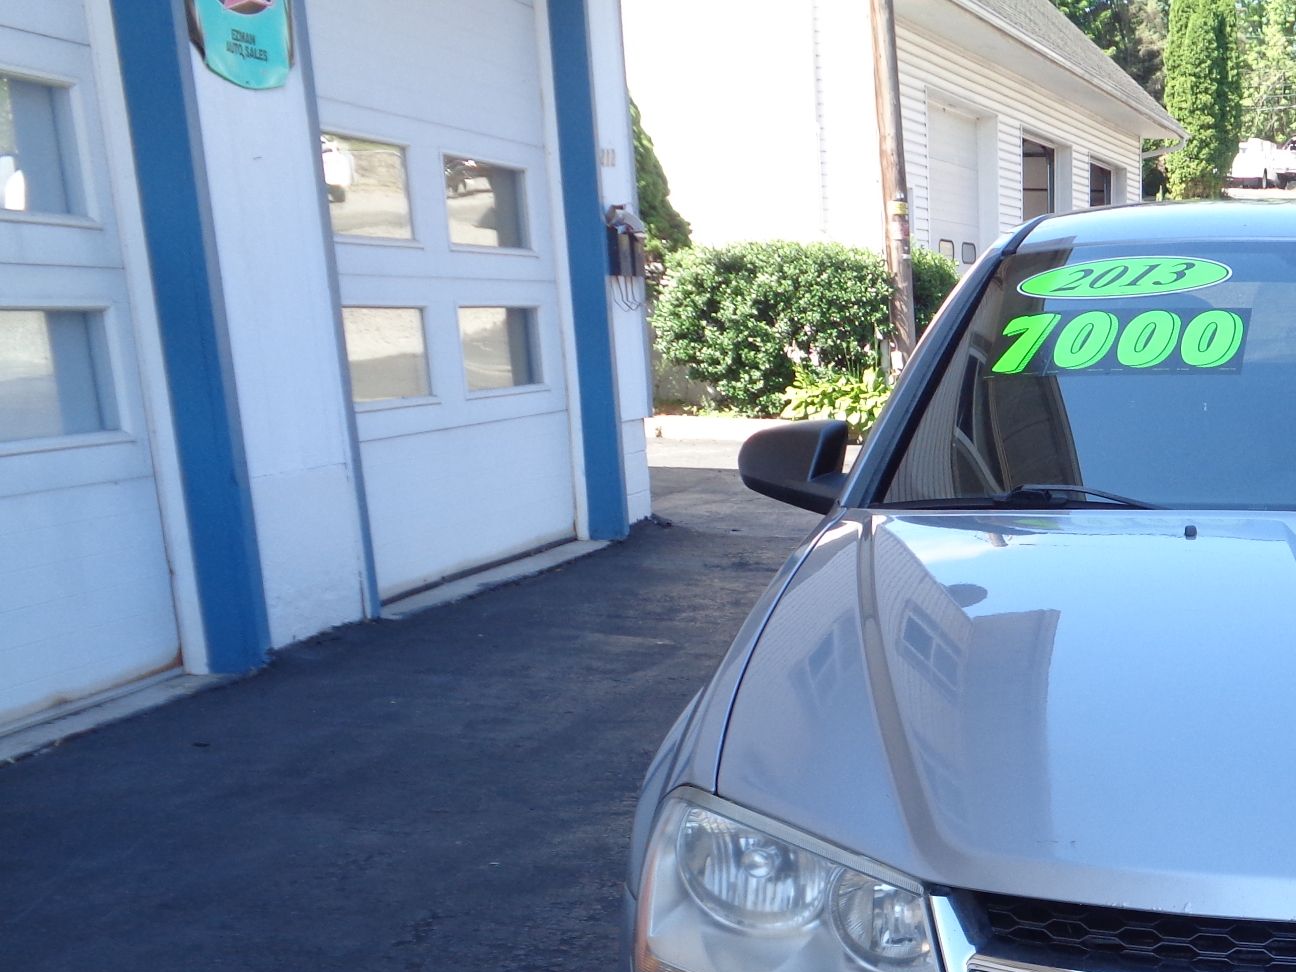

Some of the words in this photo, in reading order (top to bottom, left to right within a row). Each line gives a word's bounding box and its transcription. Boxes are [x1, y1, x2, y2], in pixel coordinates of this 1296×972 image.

[245, 45, 268, 62] SALES
[1050, 262, 1196, 293] 2013
[991, 309, 1245, 374] 7000
